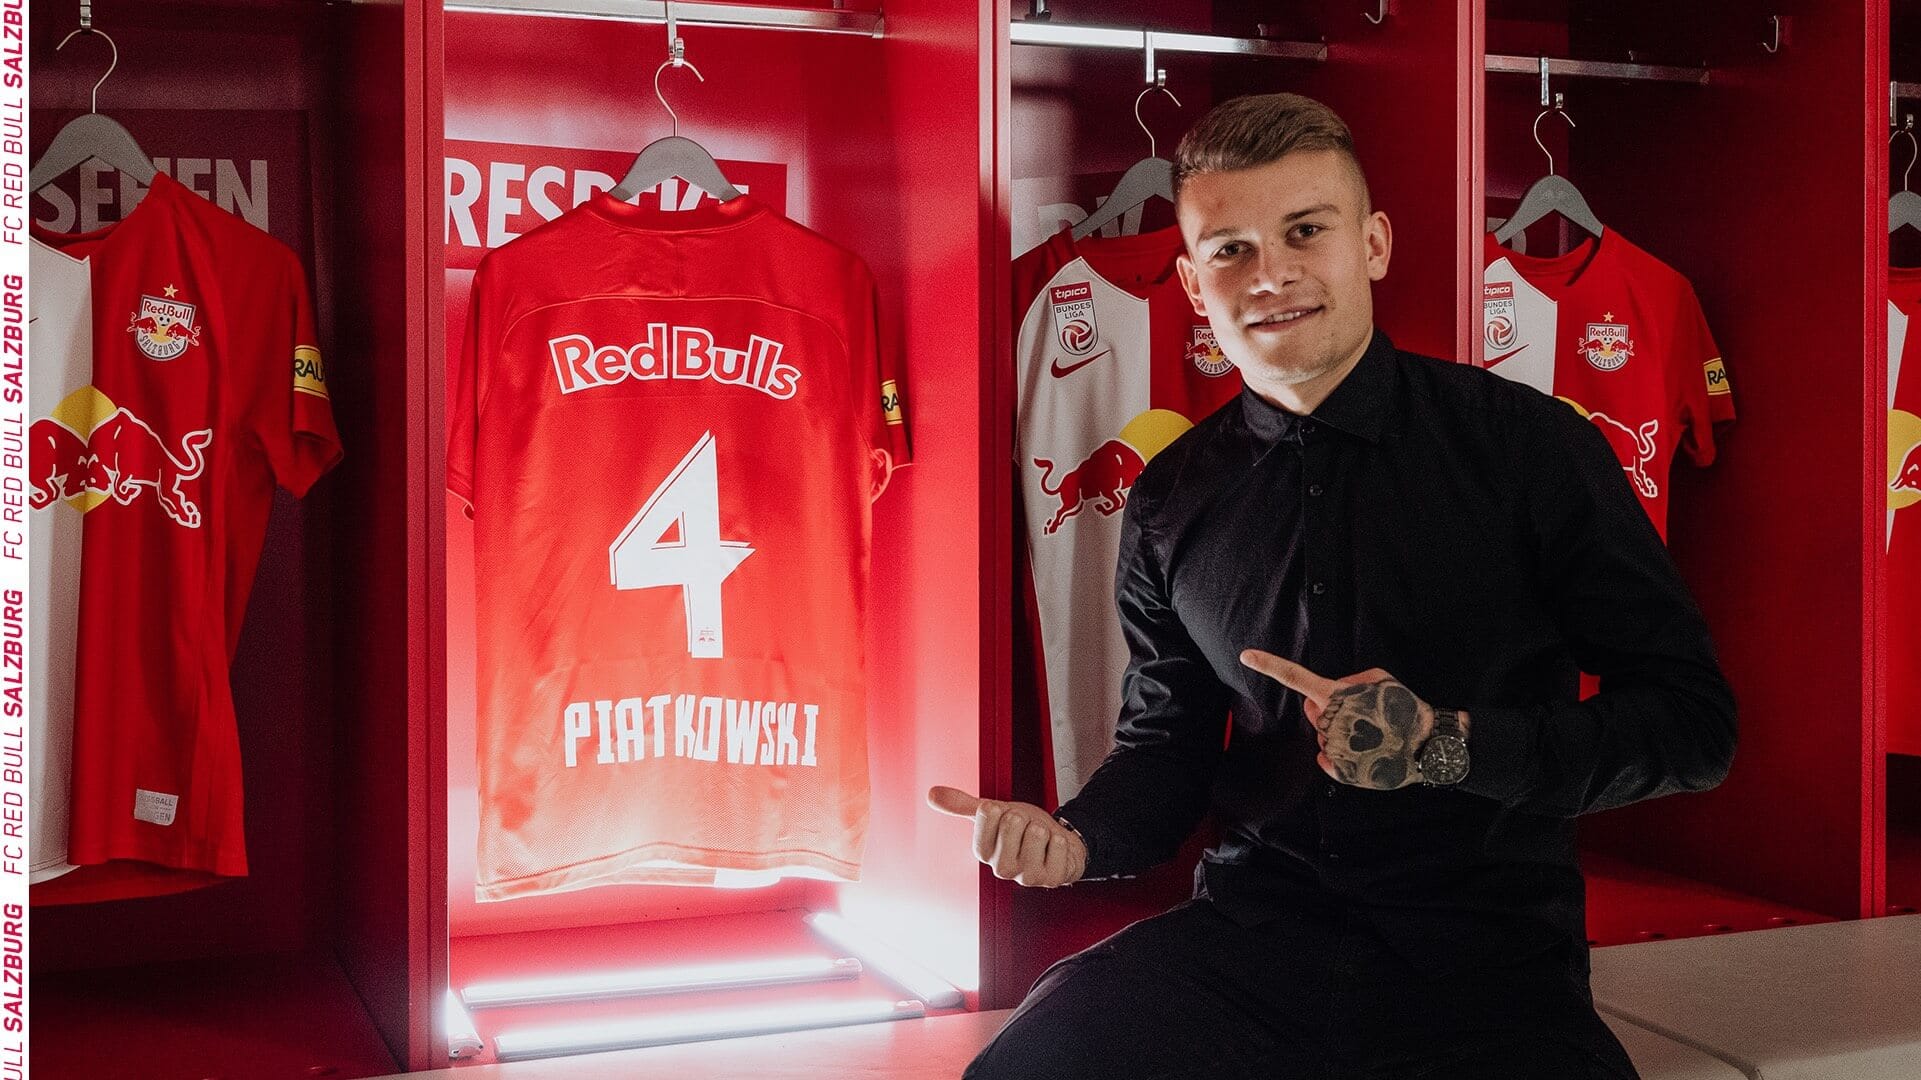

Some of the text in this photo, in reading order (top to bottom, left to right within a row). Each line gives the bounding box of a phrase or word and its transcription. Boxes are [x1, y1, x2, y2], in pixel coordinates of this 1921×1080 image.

[1055, 287, 1088, 299] tipico
[1484, 286, 1511, 296] tipico
[1056, 302, 1091, 313] BUNDES
[1484, 300, 1513, 309] BUNDES
[1065, 310, 1084, 319] LIGA
[140, 335, 181, 356] SALZBURG
[1591, 353, 1624, 368] SALZBURG
[609, 430, 757, 659] 4
[563, 694, 819, 768] PIATKOWSKI
